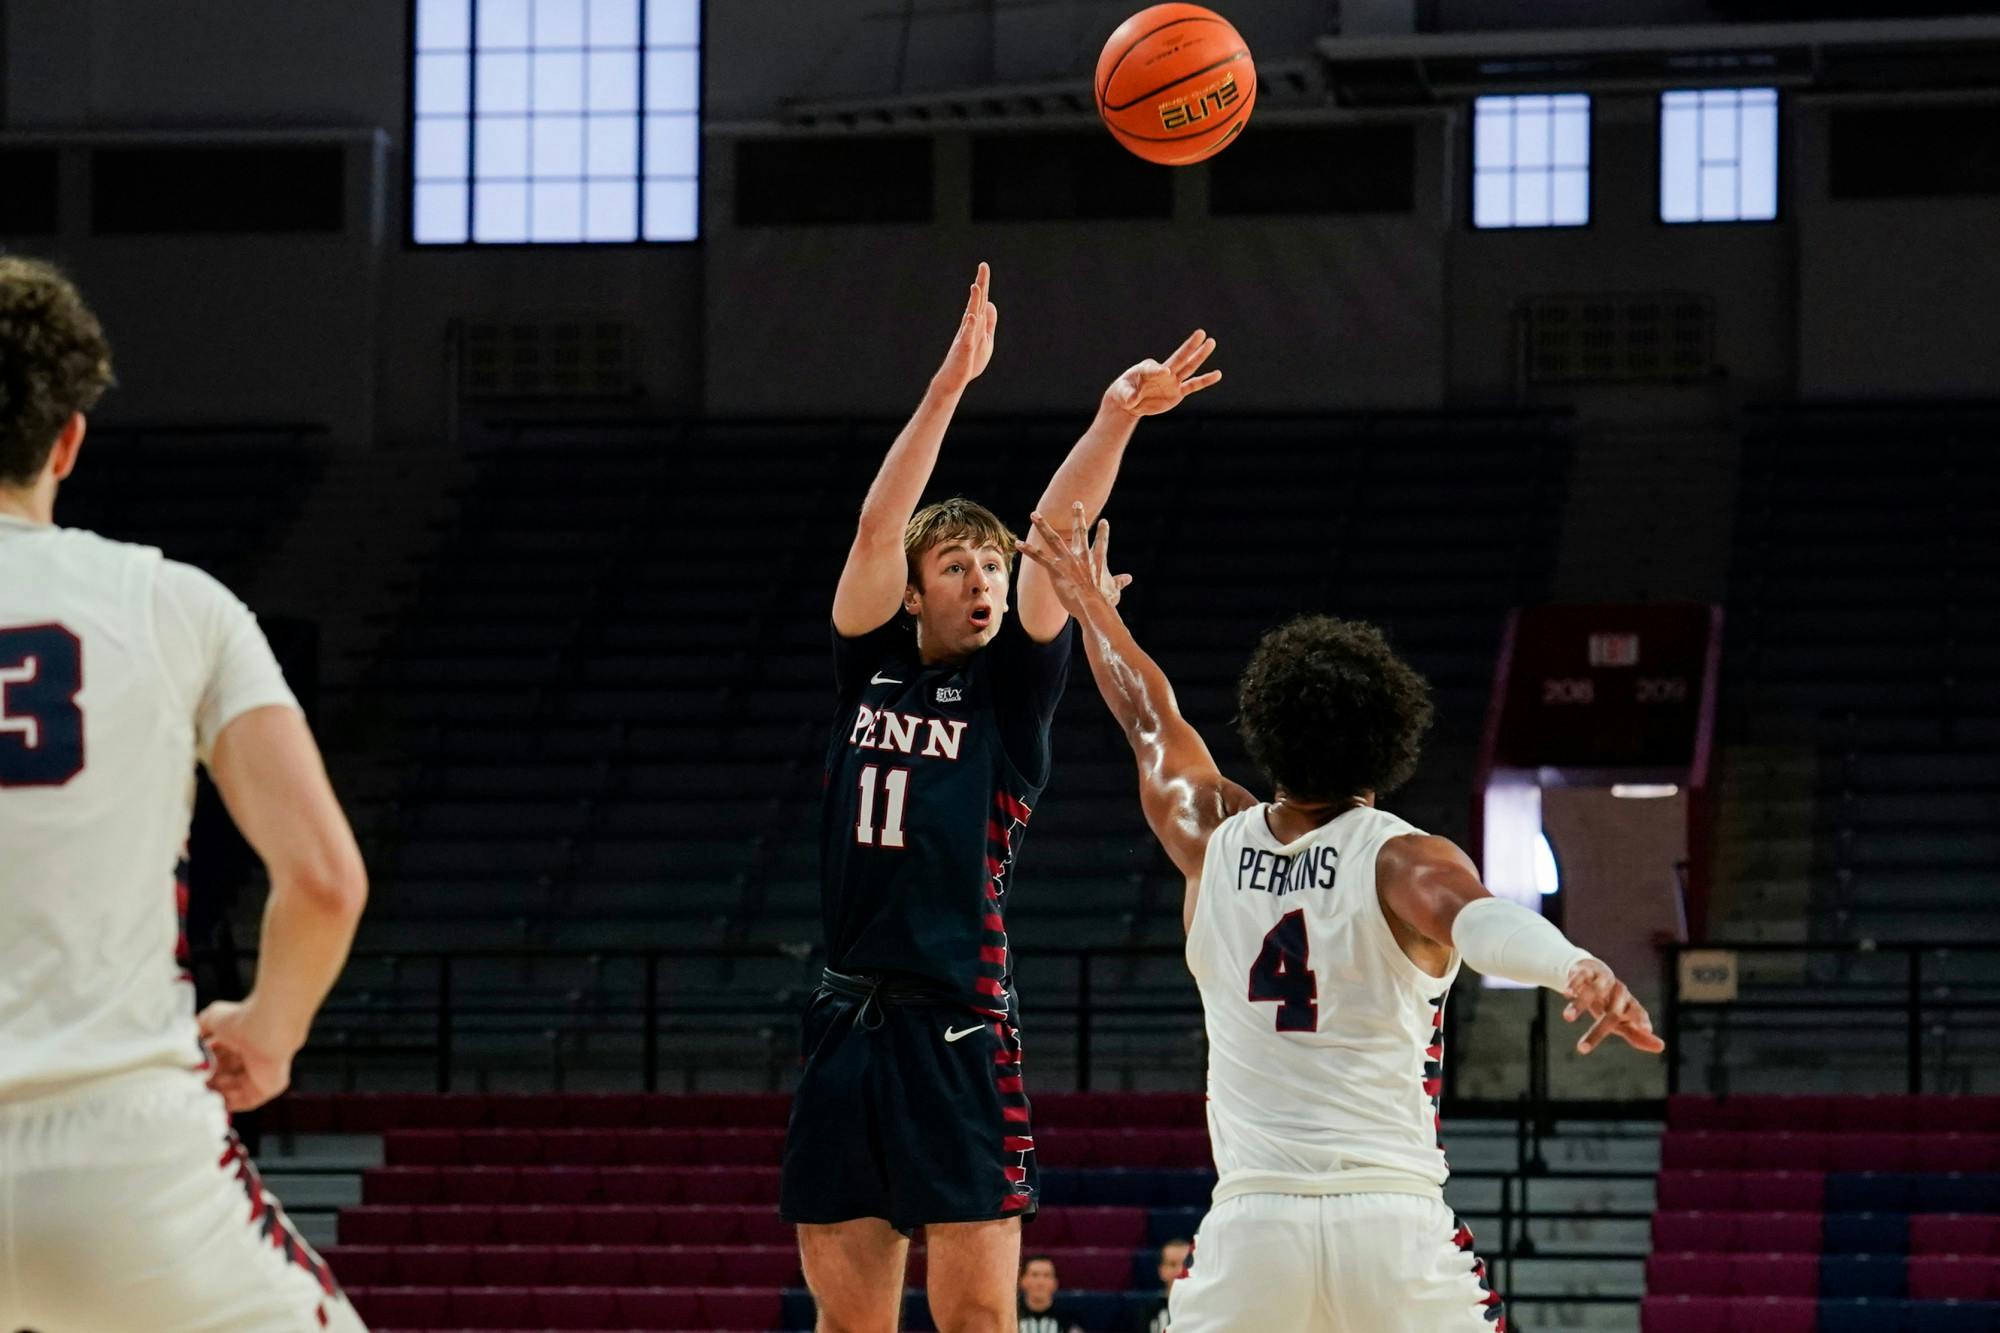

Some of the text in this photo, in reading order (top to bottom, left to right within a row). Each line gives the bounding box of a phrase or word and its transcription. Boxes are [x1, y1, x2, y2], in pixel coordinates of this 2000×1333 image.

[1159, 79, 1239, 131] ELITE
[0, 623, 85, 788] 3
[849, 703, 967, 760] PENN
[855, 763, 912, 851] 11
[1248, 908, 1318, 1032] 4
